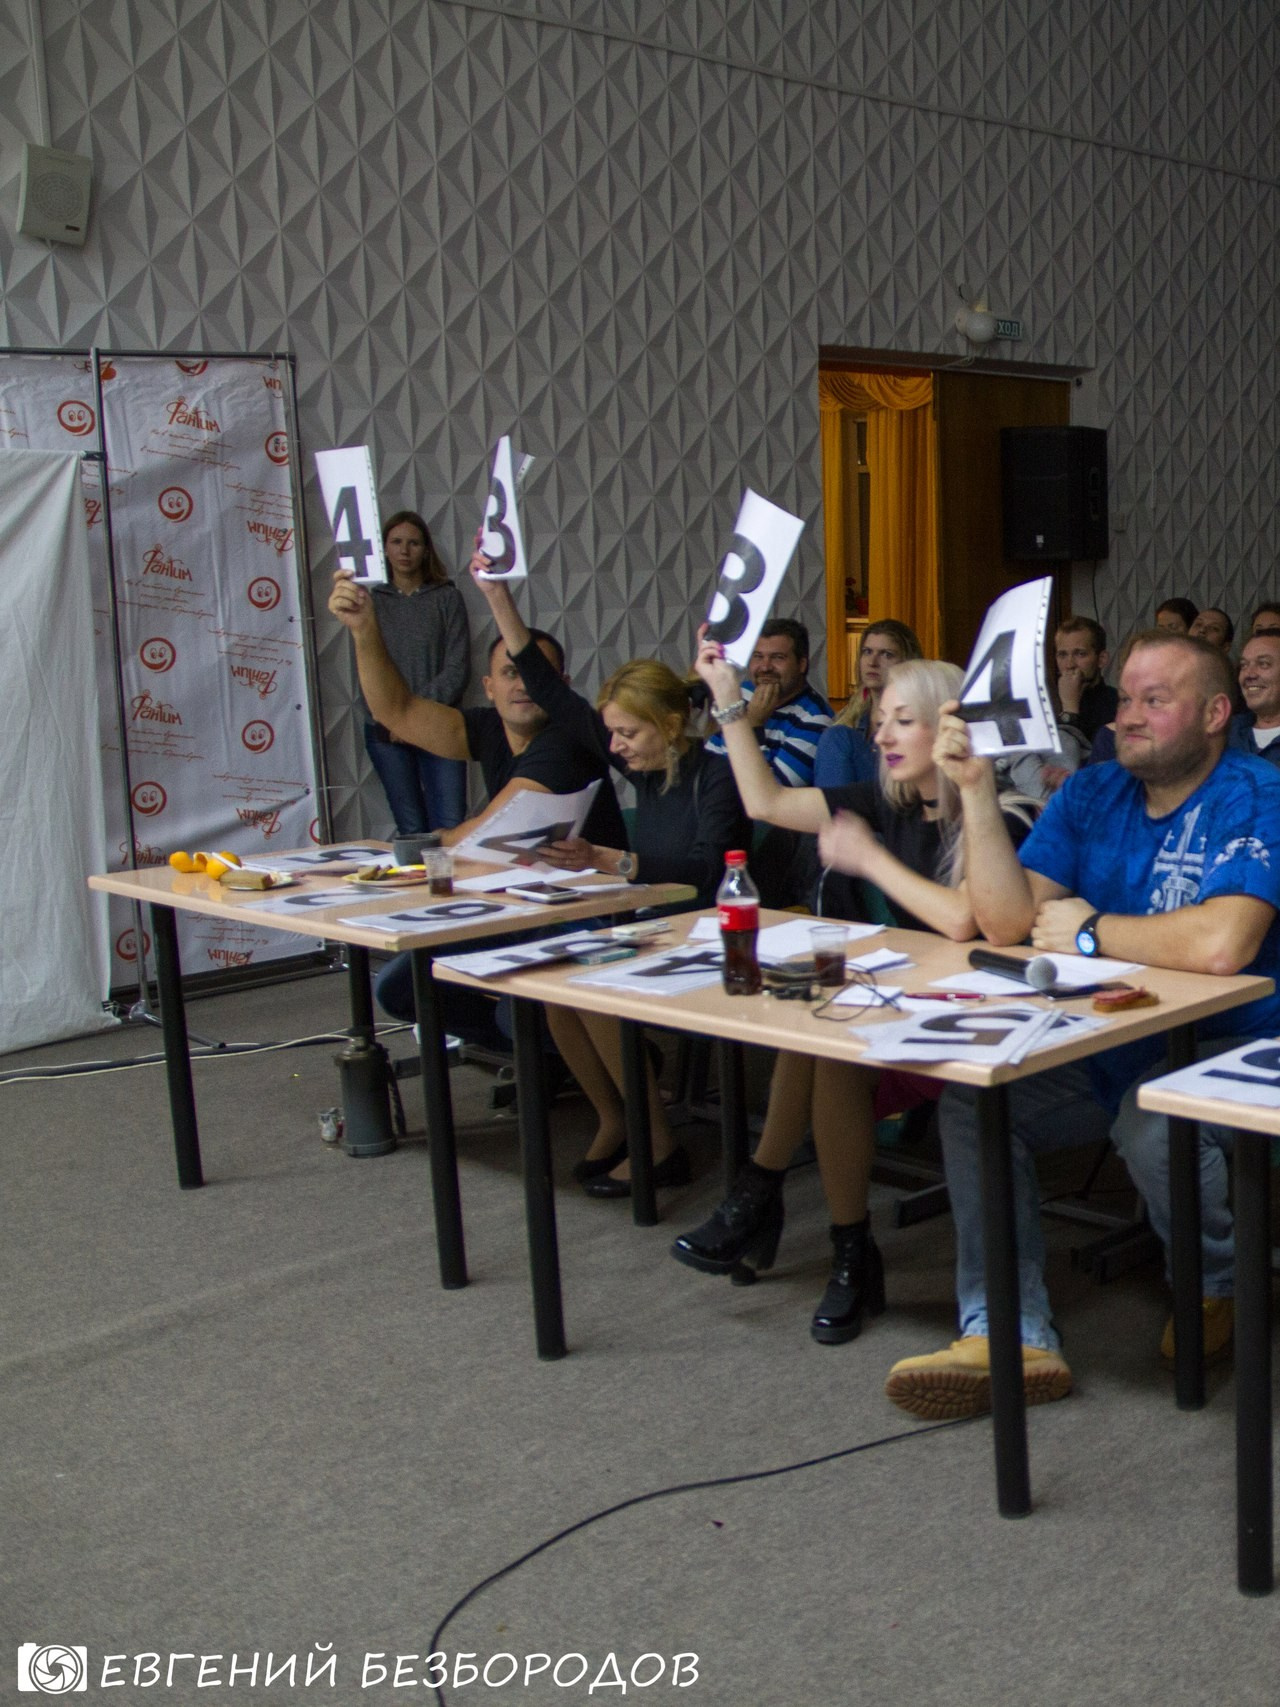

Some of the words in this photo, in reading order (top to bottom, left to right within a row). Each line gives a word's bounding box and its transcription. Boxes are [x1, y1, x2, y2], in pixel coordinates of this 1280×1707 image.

[998, 321, 1019, 337] ХОД
[333, 485, 373, 578] 4
[478, 477, 516, 574] 3
[957, 629, 1032, 746] 4
[900, 1013, 1085, 1045] 5
